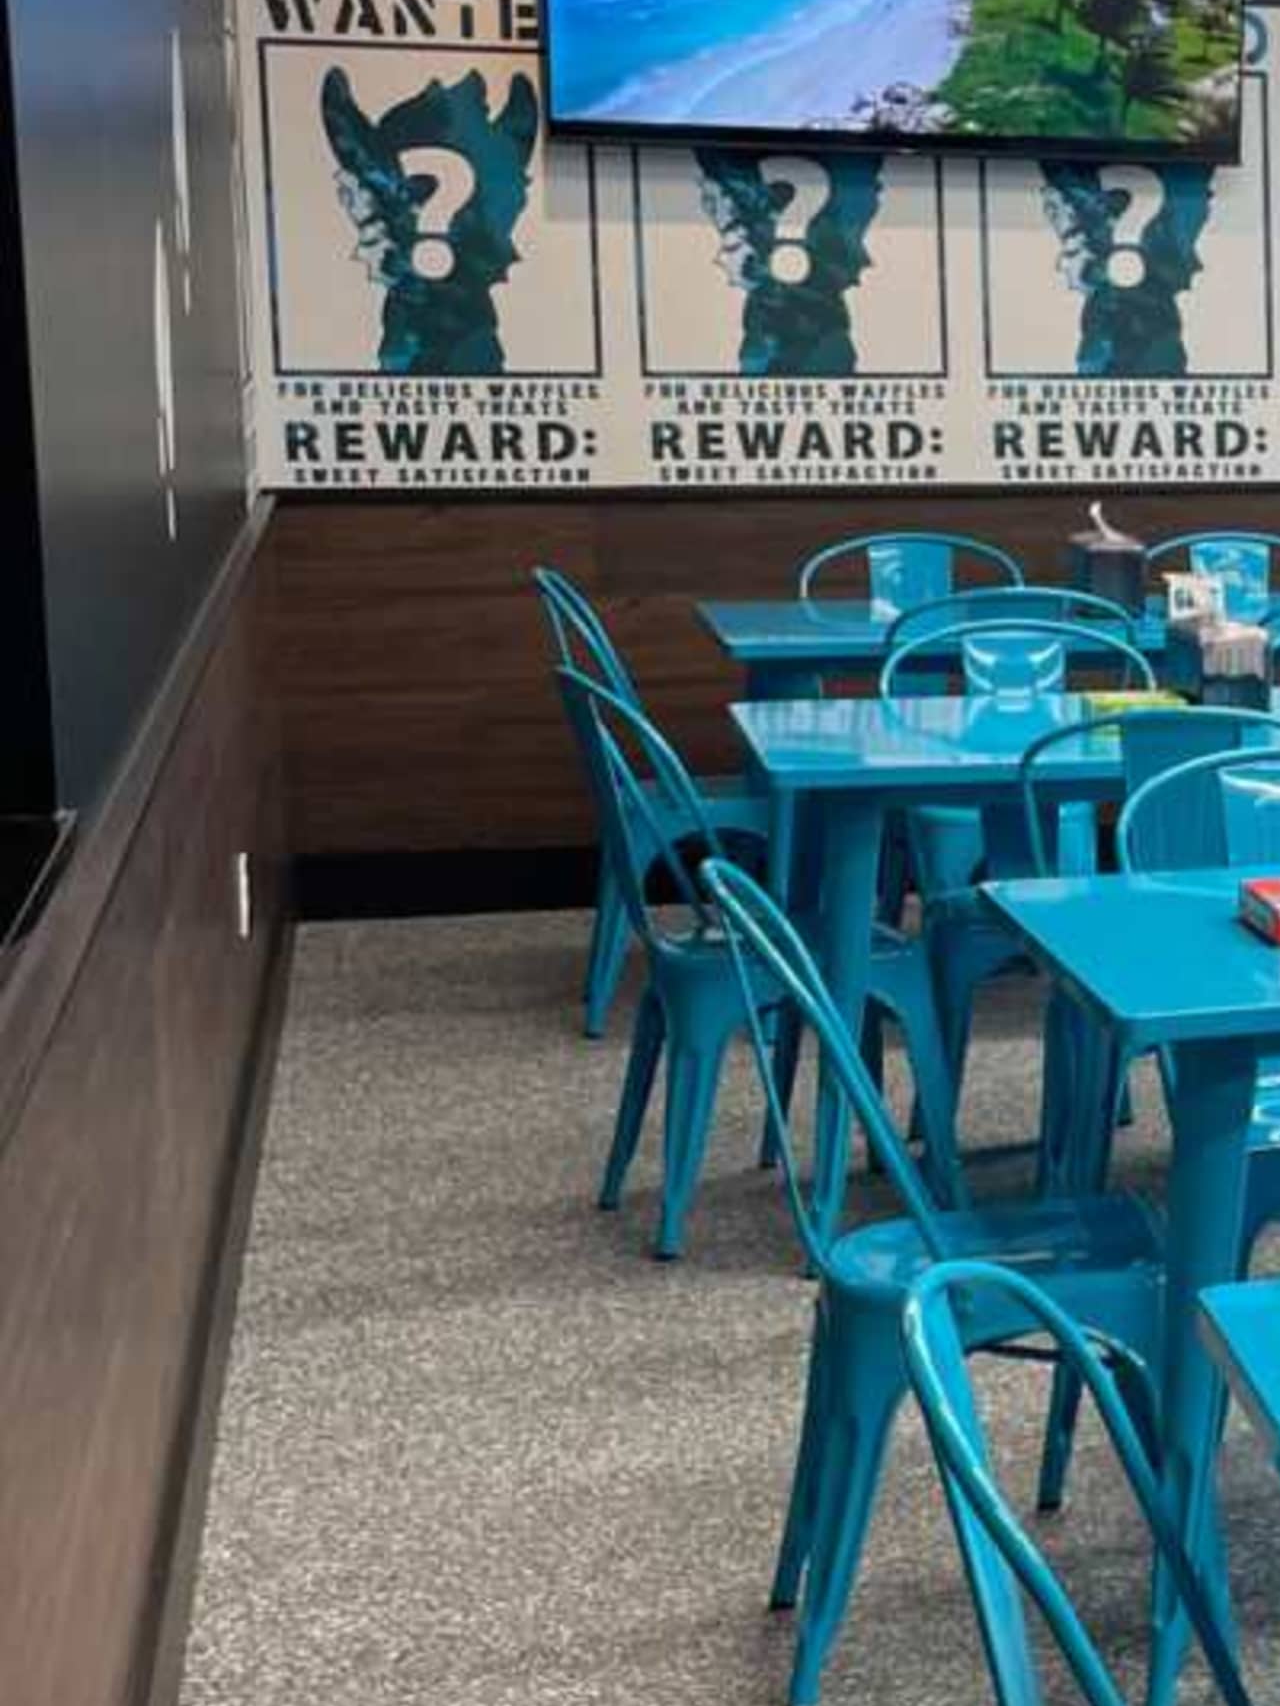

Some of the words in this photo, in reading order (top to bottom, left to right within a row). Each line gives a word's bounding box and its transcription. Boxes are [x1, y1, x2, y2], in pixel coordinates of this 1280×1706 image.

[285, 421, 597, 462] REWARD:
[651, 421, 942, 460] REWARD:
[993, 421, 1268, 459] REWARD:
